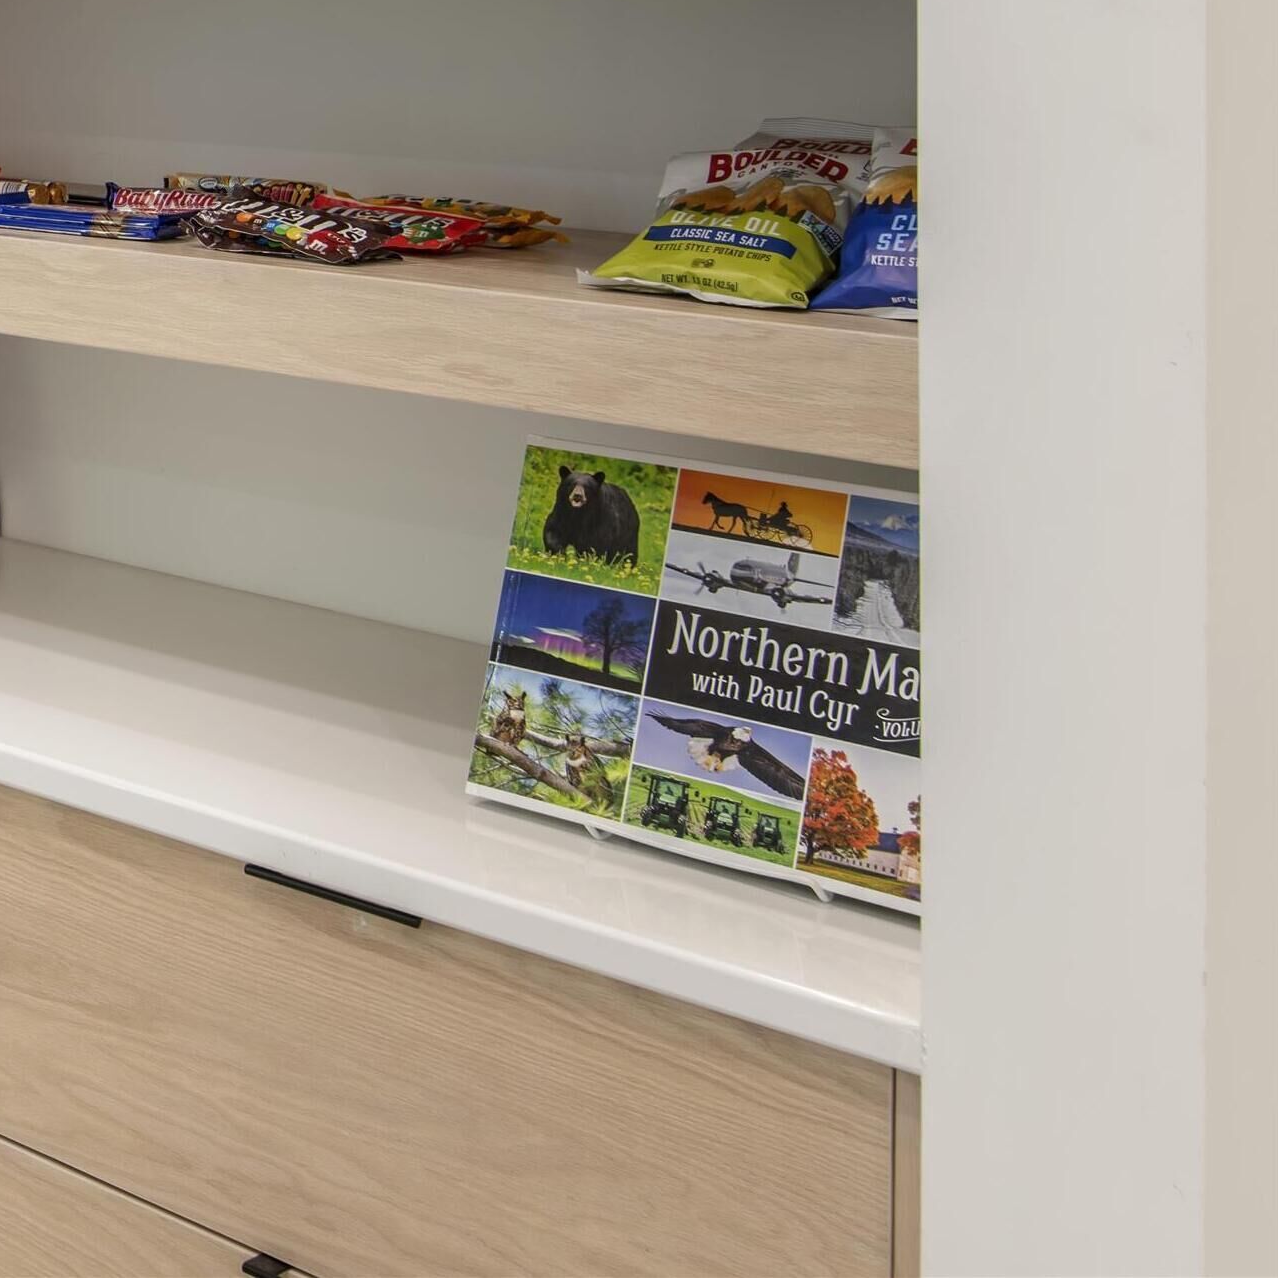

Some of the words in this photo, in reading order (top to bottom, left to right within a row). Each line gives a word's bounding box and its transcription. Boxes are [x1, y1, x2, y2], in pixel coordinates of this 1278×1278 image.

[706, 149, 849, 184] BOULDER
[744, 217, 781, 236] OIL
[670, 228, 711, 241] CLASSIC
[714, 231, 738, 243] SEA
[740, 235, 768, 248] SALT
[653, 241, 682, 252] KETTLE
[684, 243, 711, 253] STYLE
[712, 246, 745, 258] POTATO
[746, 250, 772, 262] CHIPS
[871, 255, 905, 267] KETTLE
[661, 273, 674, 283] NET
[666, 609, 849, 687] Northern
[692, 672, 741, 702] with
[747, 675, 801, 715] Paul
[809, 689, 859, 732] Cyr
